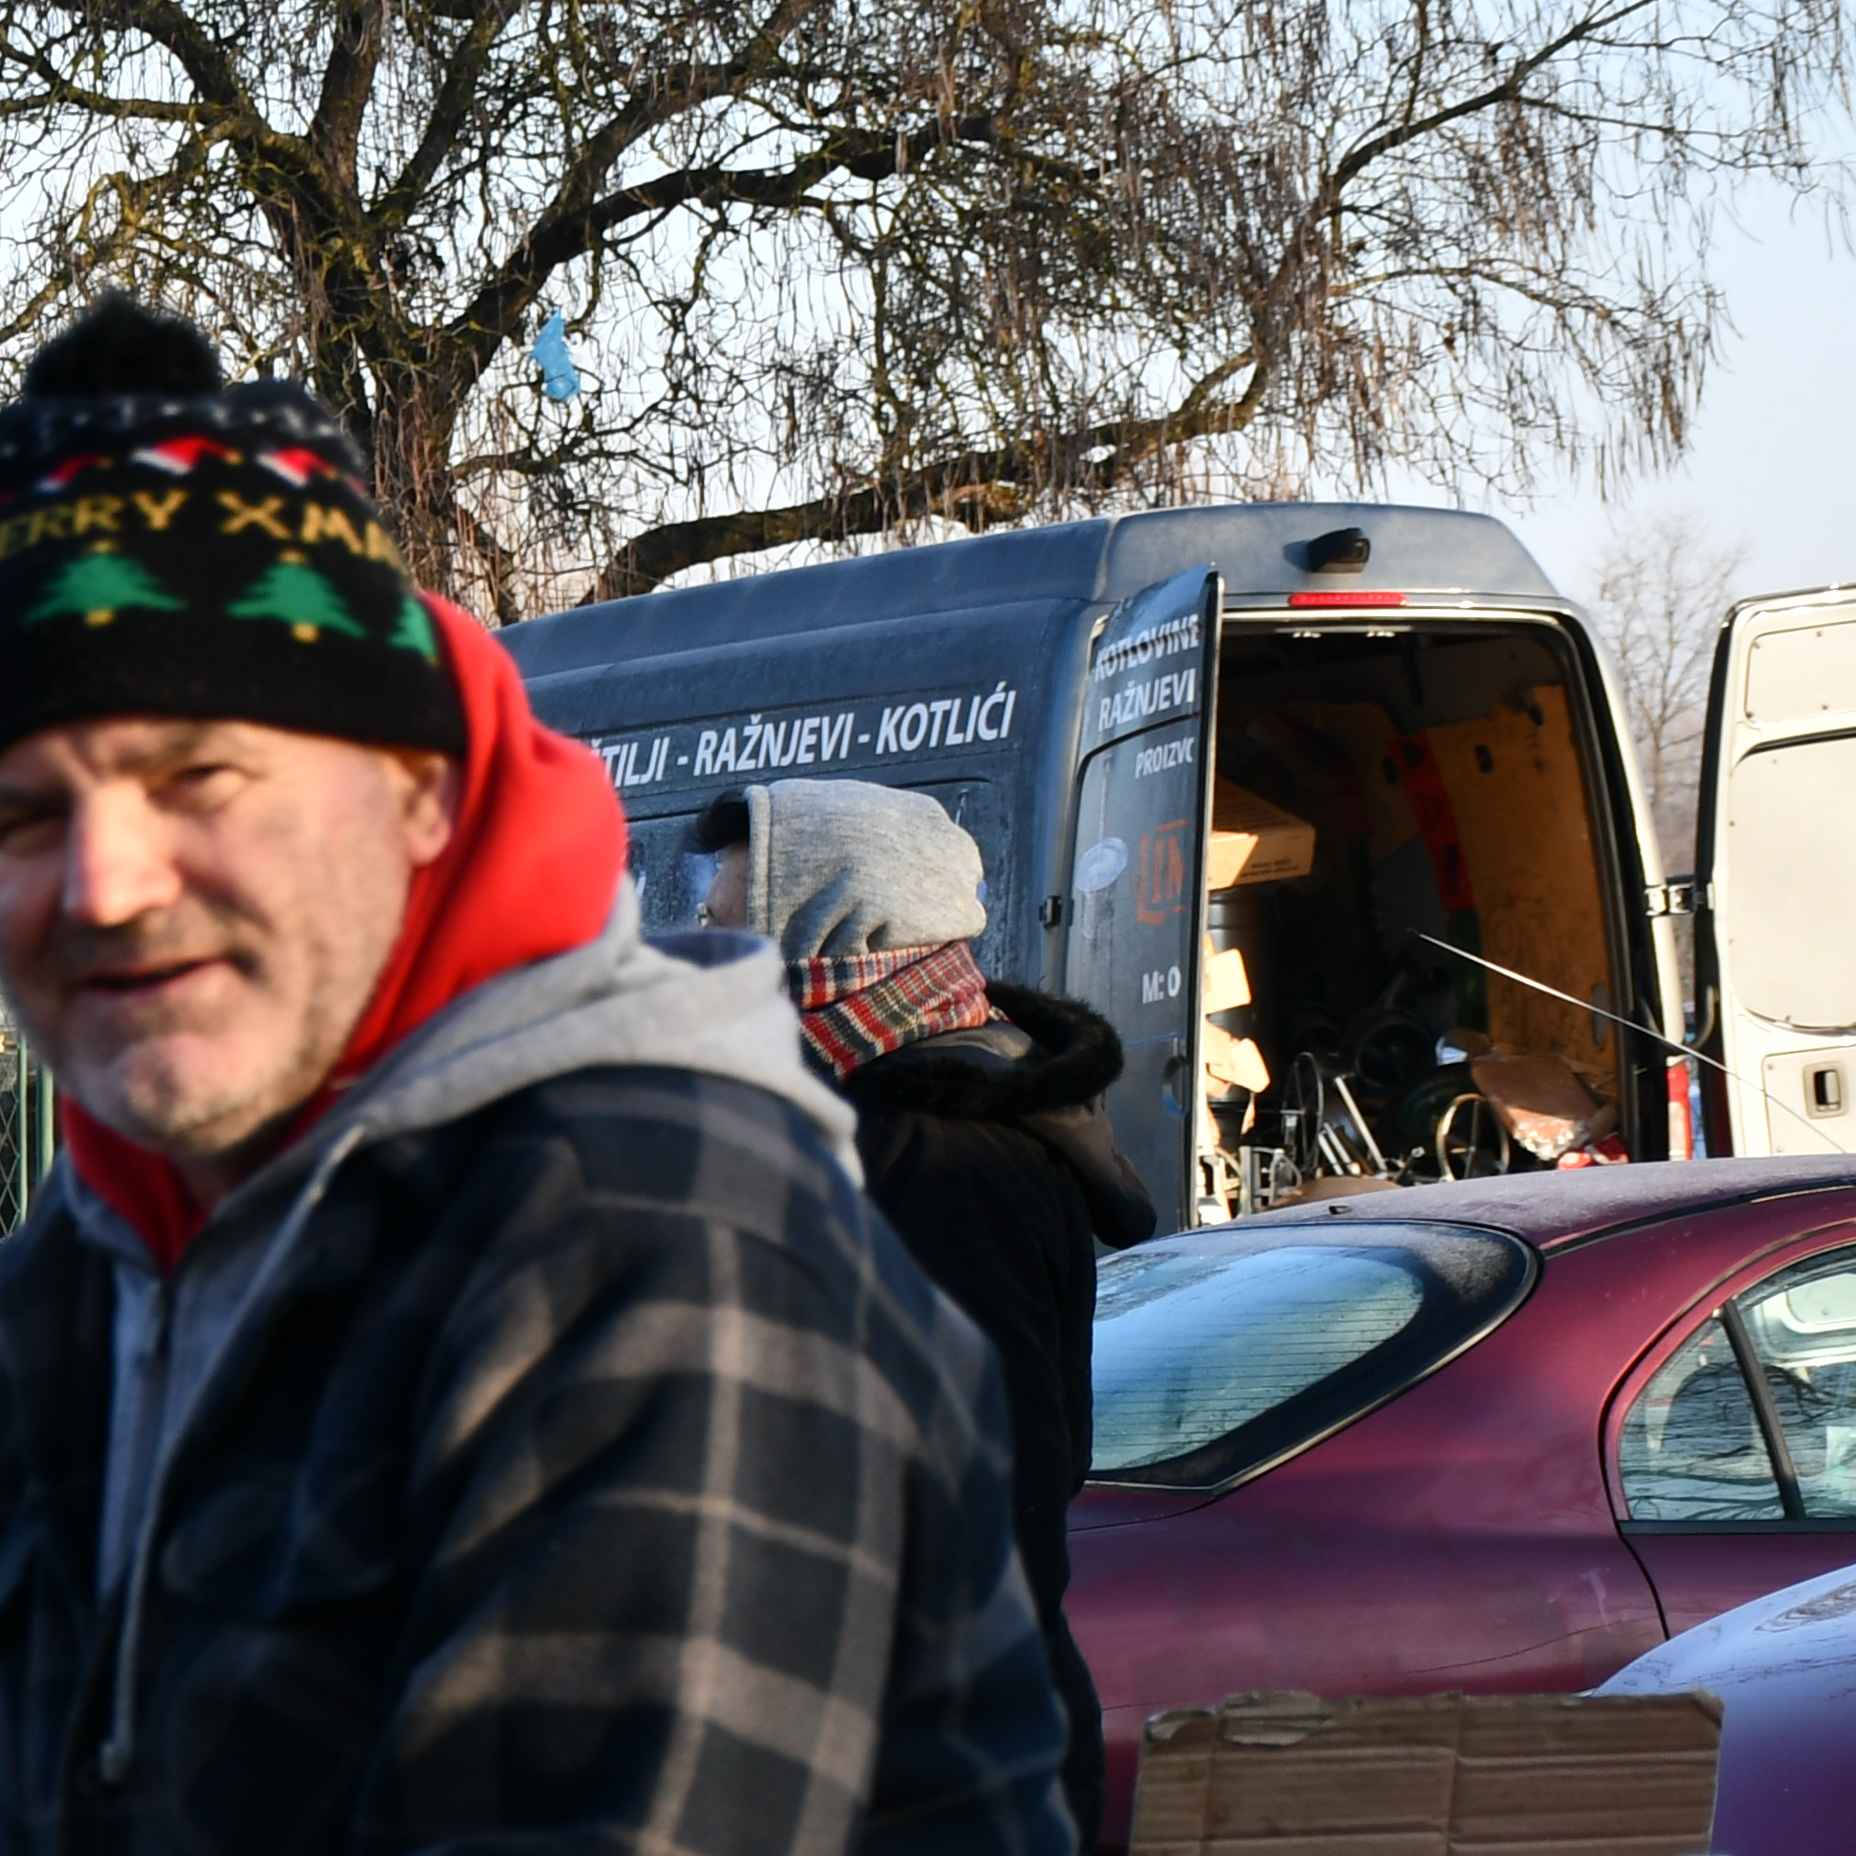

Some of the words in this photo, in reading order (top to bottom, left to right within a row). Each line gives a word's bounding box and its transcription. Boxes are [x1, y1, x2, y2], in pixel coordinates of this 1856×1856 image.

[591, 737, 671, 788] TILJI
[693, 714, 855, 776] RAŽNJEVI
[876, 681, 1017, 755] KOTLIĆI
[1098, 668, 1197, 732] RAŽNJEVI
